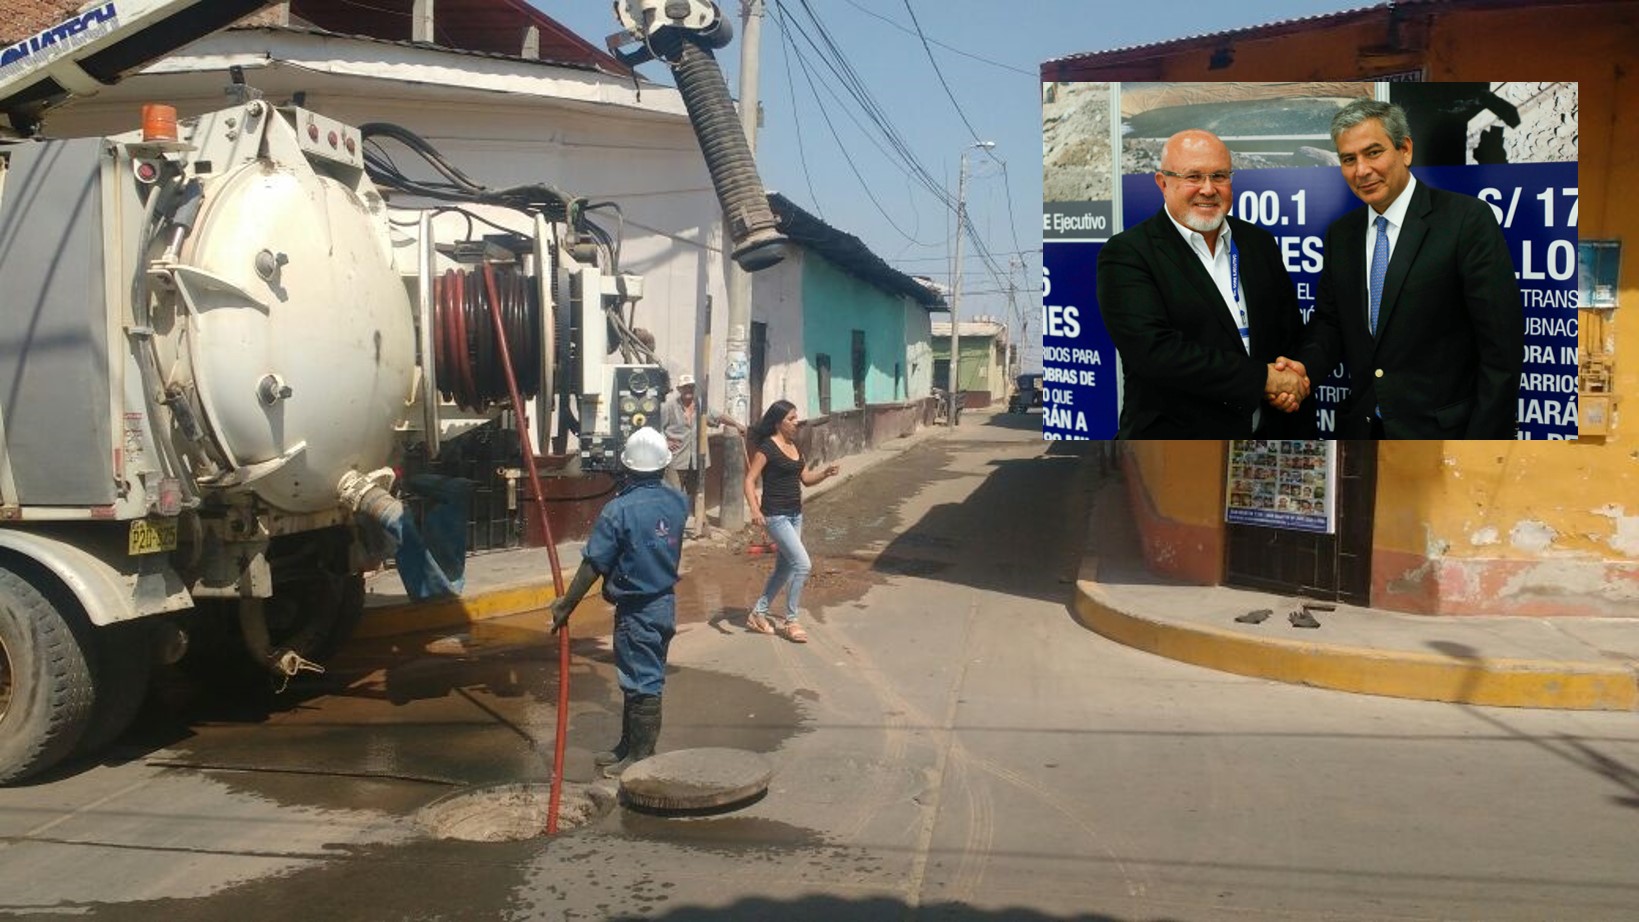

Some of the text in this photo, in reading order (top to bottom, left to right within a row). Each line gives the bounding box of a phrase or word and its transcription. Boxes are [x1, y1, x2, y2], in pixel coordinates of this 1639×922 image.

[1228, 189, 1306, 226] 00.1
[1053, 213, 1106, 234] Ejecutivo
[1274, 235, 1324, 273] ES
[1515, 239, 1575, 280] LO
[1297, 282, 1315, 300] EL
[1520, 289, 1578, 308] TRANS
[1072, 348, 1101, 365] PARA
[1080, 371, 1096, 387] DE
[1052, 388, 1074, 405] QUE
[1075, 411, 1088, 432] A
